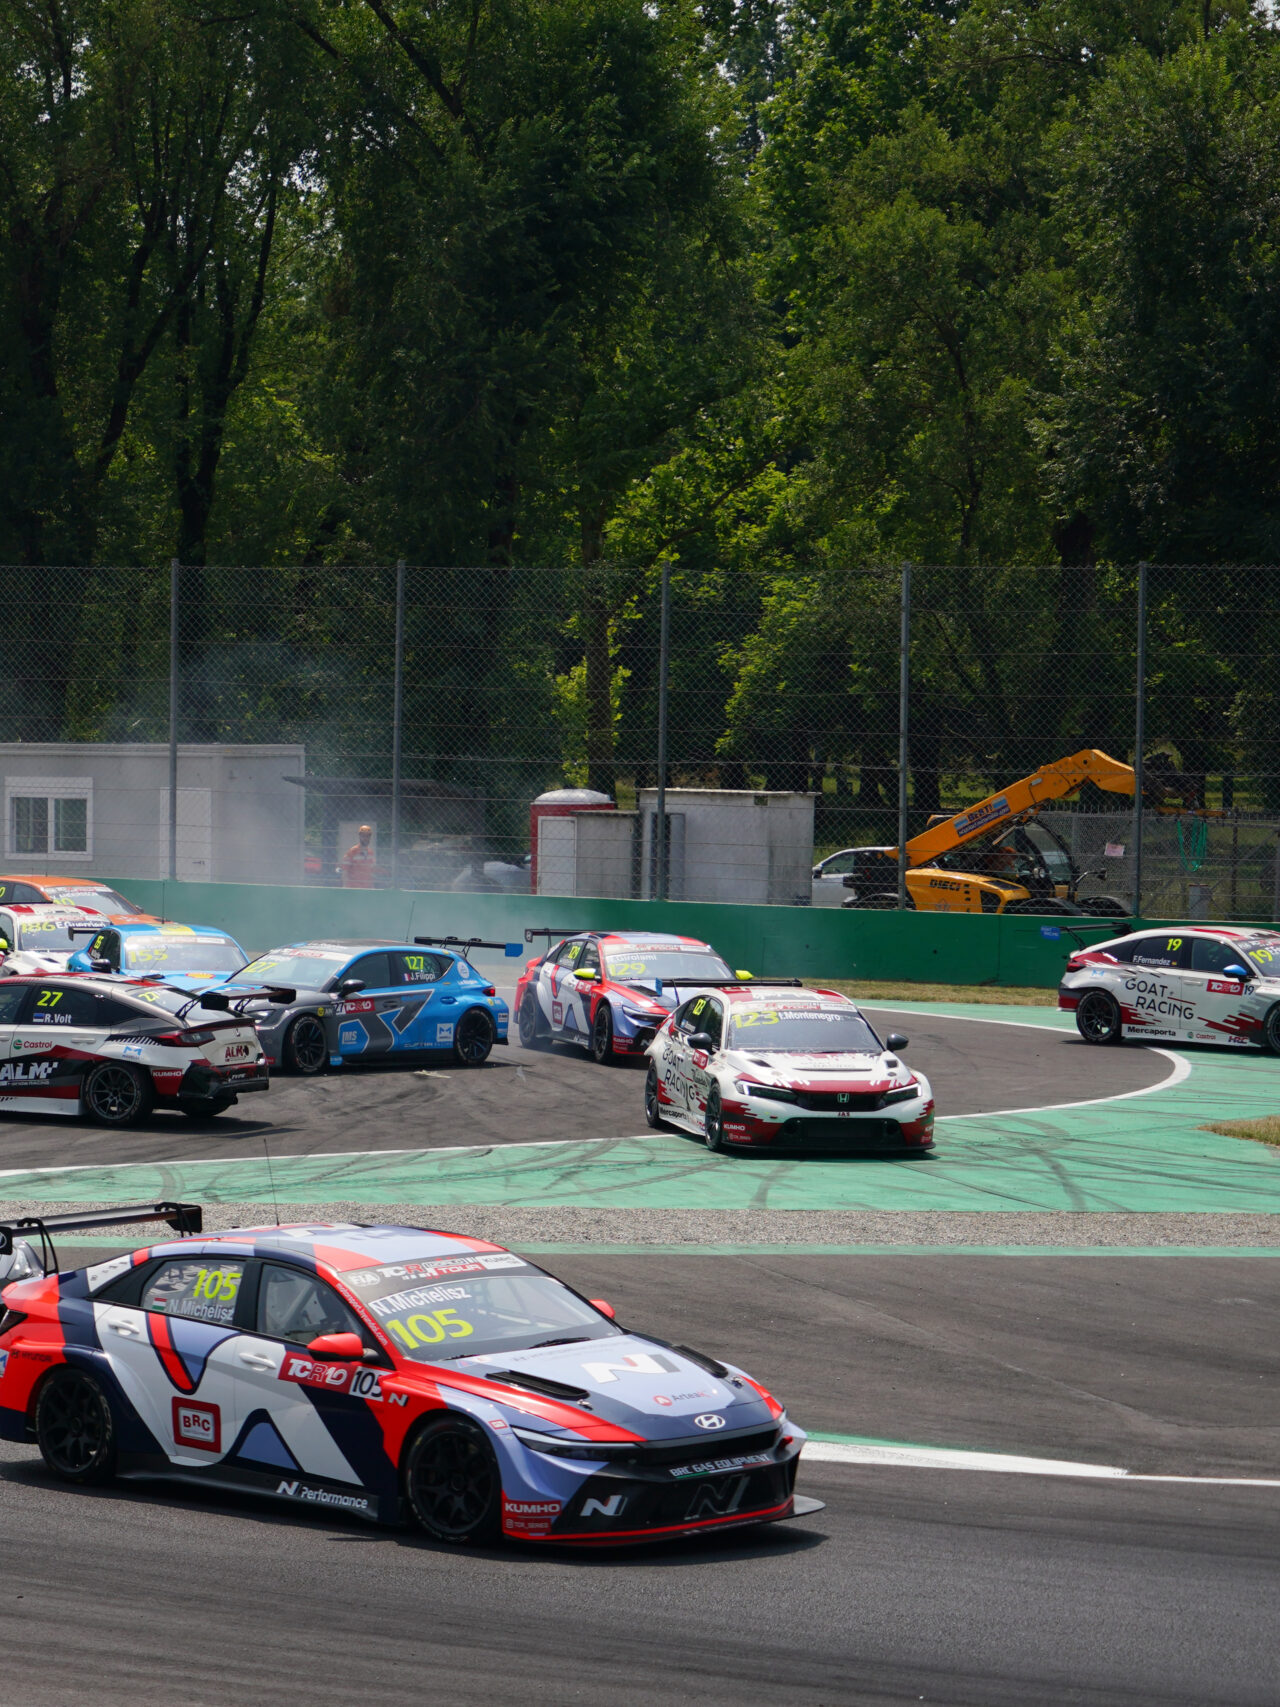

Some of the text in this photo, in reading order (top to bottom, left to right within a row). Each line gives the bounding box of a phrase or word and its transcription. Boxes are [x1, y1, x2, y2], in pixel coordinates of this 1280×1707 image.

[21, 922, 57, 933] 186
[1166, 938, 1182, 951] 19
[130, 949, 168, 963] 155
[405, 955, 424, 971] 127
[1249, 949, 1273, 964] 19
[608, 962, 647, 977] 129
[1125, 978, 1169, 998] GOAT
[1244, 985, 1255, 996] 19
[37, 990, 64, 1007] 27
[1135, 995, 1195, 1021] RACING
[44, 1012, 72, 1024] R.Volt
[732, 1010, 780, 1029] 123
[1127, 1025, 1177, 1037] Mercaporta
[23, 1038, 53, 1049] Castrol
[662, 1048, 683, 1072] GOAT
[664, 1068, 696, 1101] RACING
[439, 1263, 482, 1275] TOUR
[193, 1269, 243, 1301] 105
[169, 1299, 234, 1321] N.Michelisz
[368, 1286, 473, 1318] N.Michelisz
[385, 1307, 474, 1350] 105
[182, 1415, 211, 1433] BRC
[670, 1453, 770, 1478] BRC GAS EQUIPMENT
[300, 1487, 369, 1509] Performance
[505, 1501, 562, 1513] KUMHO
